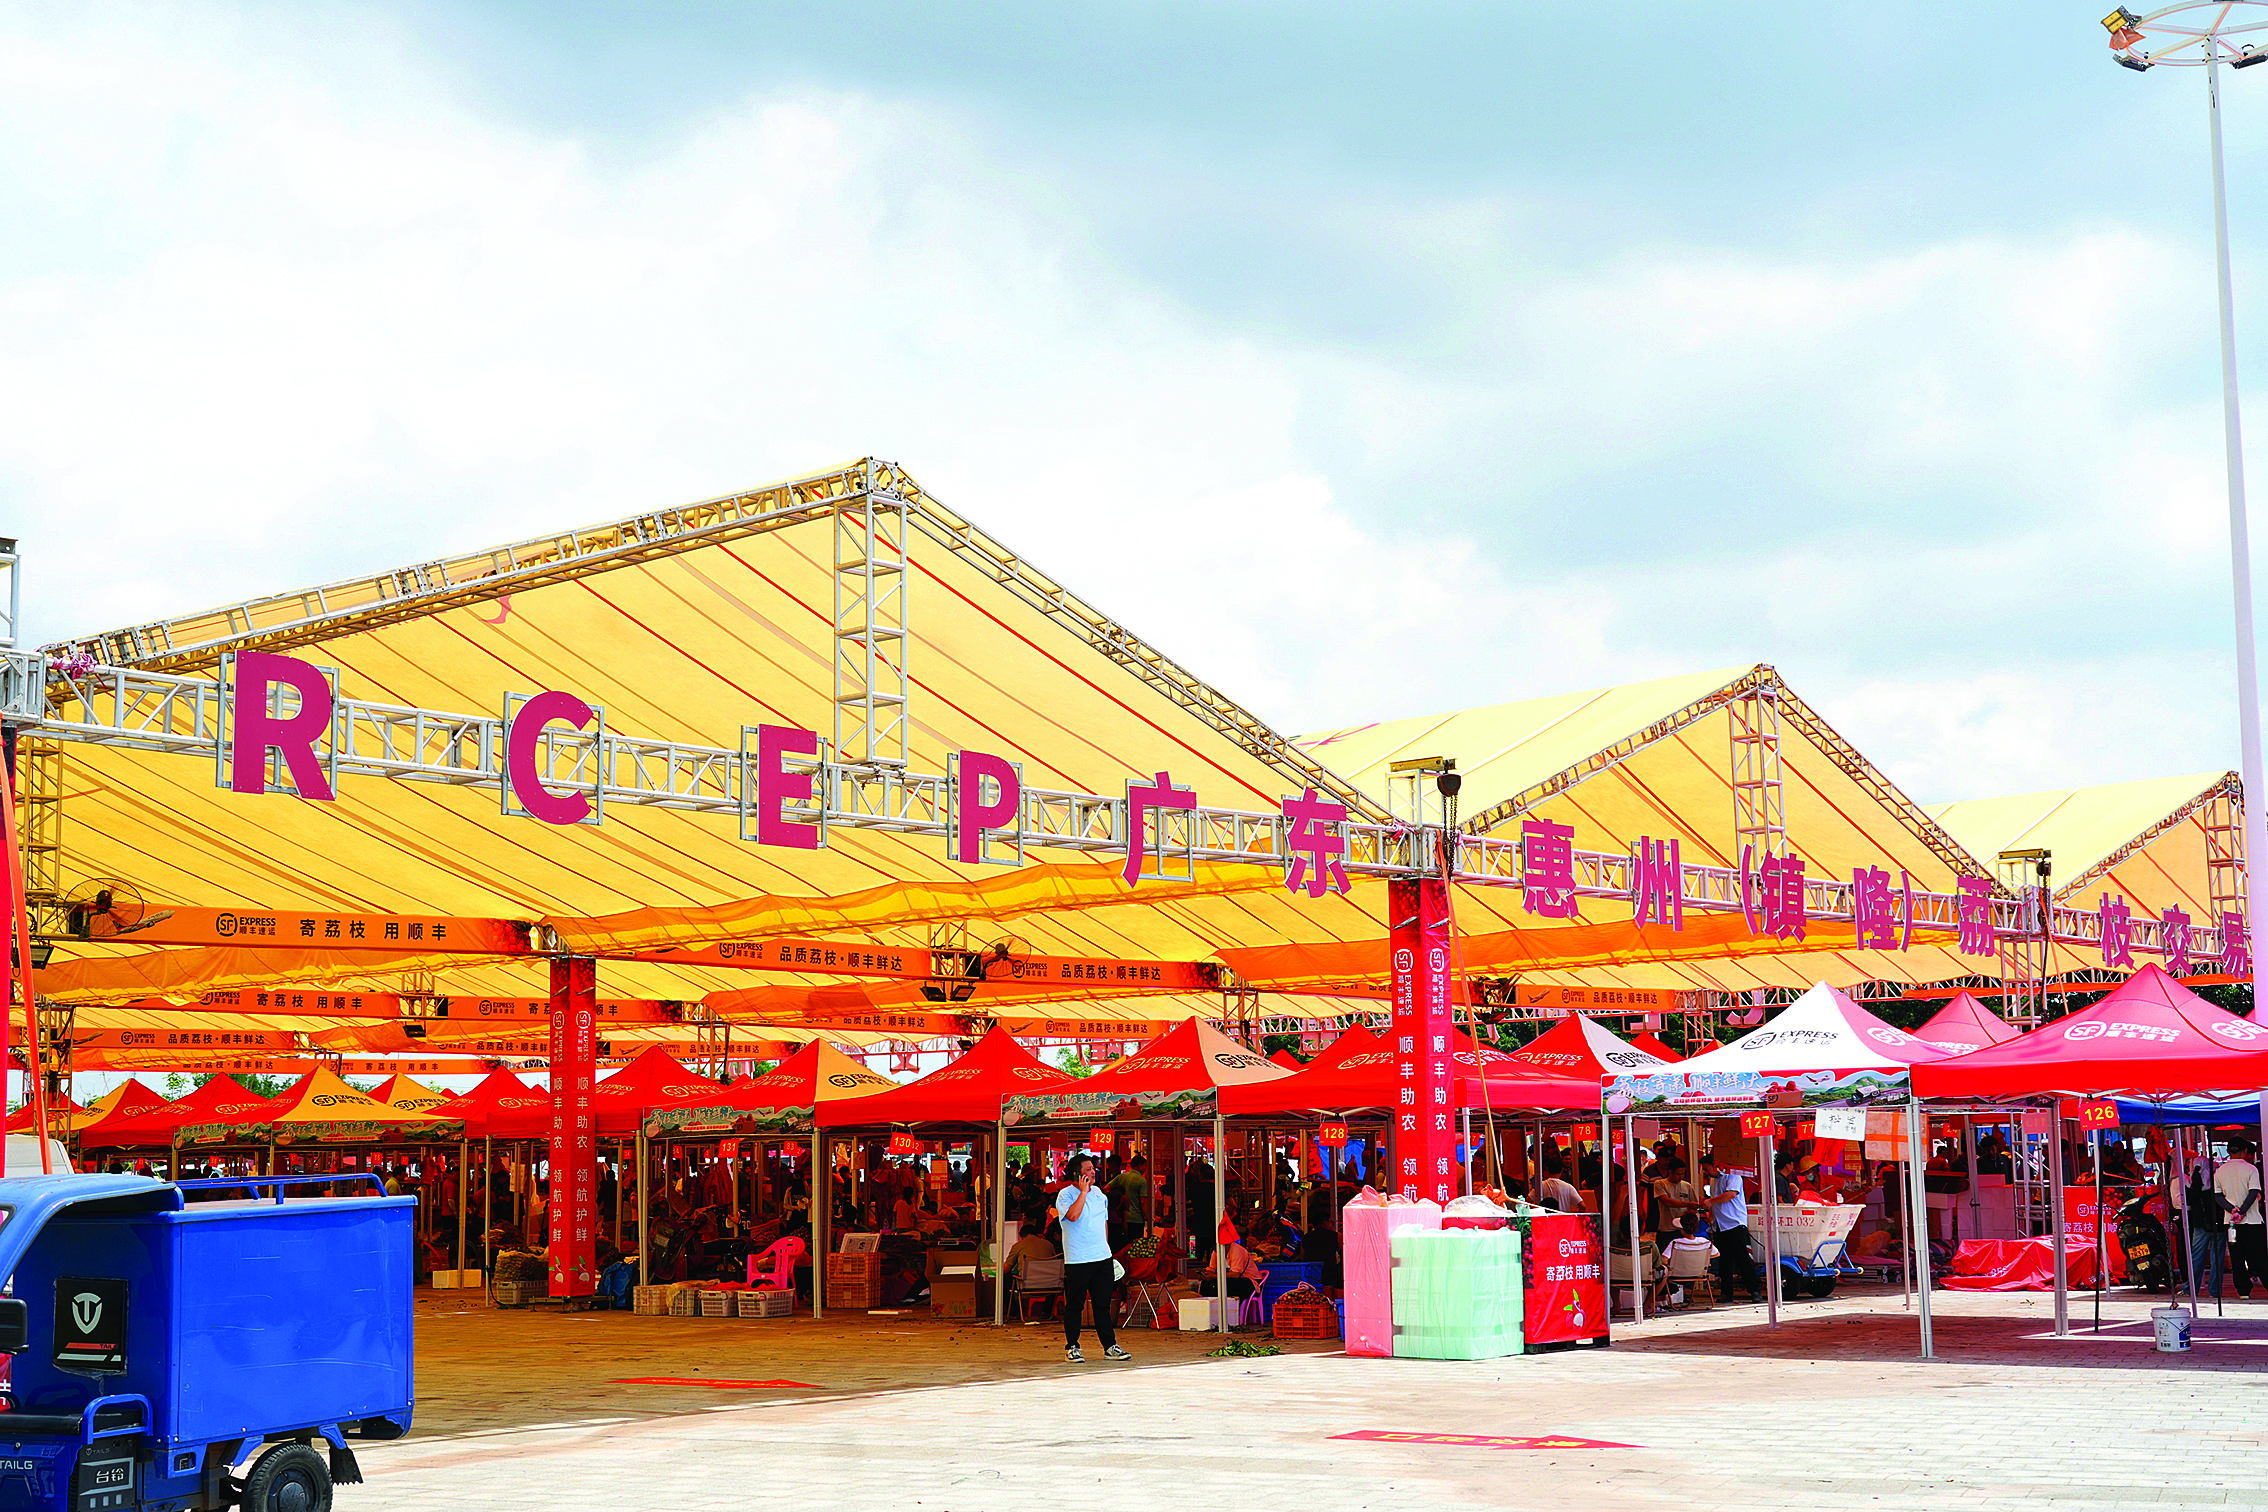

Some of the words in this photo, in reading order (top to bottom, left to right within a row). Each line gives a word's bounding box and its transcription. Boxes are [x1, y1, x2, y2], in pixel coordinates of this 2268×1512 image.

[239, 916, 276, 927] EXPRESS
[239, 926, 276, 936] 顺丰速运
[300, 919, 366, 939] 寄荔枝
[384, 922, 447, 941] 用顺丰
[736, 942, 763, 951] EXPRESS
[780, 946, 902, 972] 品质荔枝·顺丰鲜达
[1025, 962, 1048, 970] EXPRESS
[1061, 964, 1161, 980] 品质荔枝·顺丰鲜达
[256, 993, 304, 1008] 寄荔枝
[316, 996, 362, 1009] 用顺丰
[1404, 974, 1413, 1016] EXPRESS
[1593, 991, 1658, 1004] 品质荔枝·顺丰鲜达
[1079, 1022, 1148, 1034] 品质荔枝·顺丰鲜达
[2108, 1022, 2182, 1037] EXPRESS
[168, 1033, 265, 1045] 品质荔枝·顺丰鲜达
[1779, 1030, 1839, 1039] EXPRESS
[1534, 1053, 1584, 1061] EXPRESS
[1399, 1035, 1416, 1131] 顺丰助农
[1432, 1035, 1447, 1131] 顺丰助农
[553, 1077, 563, 1149] 顺丰助农
[576, 1076, 588, 1149] 顺丰助农
[2084, 1105, 2115, 1121] 126
[1745, 1115, 1770, 1130] 127
[1801, 1123, 1814, 1134] 77
[1323, 1127, 1345, 1139] 128
[1578, 1126, 1592, 1135] 78
[1612, 1132, 1621, 1140] 26
[894, 1136, 911, 1148] 130
[1094, 1132, 1112, 1144] 129
[722, 1142, 736, 1152] 131
[786, 1142, 795, 1151] 83
[575, 1168, 588, 1242] 领航护鲜
[1797, 1216, 1815, 1227] 032
[1546, 1265, 1574, 1281] 寄荔枝
[1575, 1264, 1601, 1279] 用顺丰
[96, 1467, 124, 1484] 台铃
